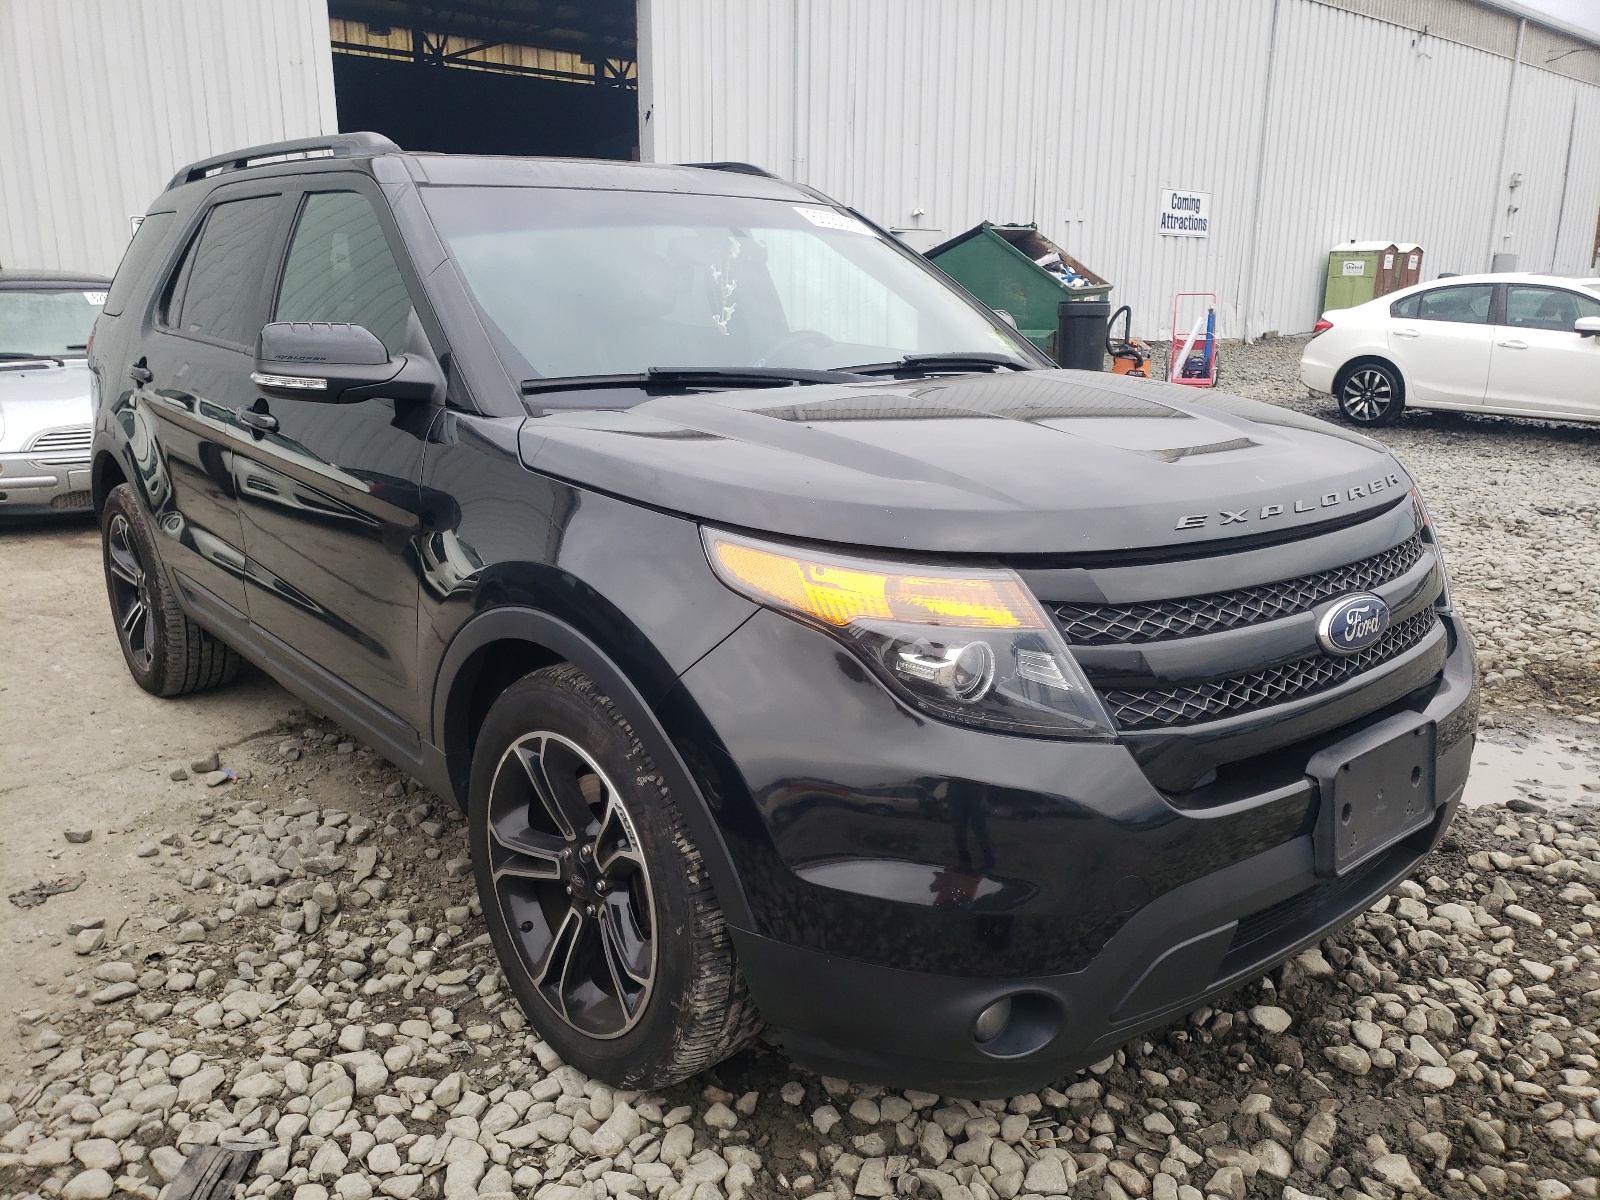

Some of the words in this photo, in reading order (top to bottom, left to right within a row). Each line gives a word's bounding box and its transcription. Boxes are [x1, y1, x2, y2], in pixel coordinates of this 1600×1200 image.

[1171, 192, 1201, 214] Coming
[1160, 212, 1208, 231] Attractions
[1175, 472, 1399, 530] EXPLORER
[1345, 605, 1380, 641] Ford
